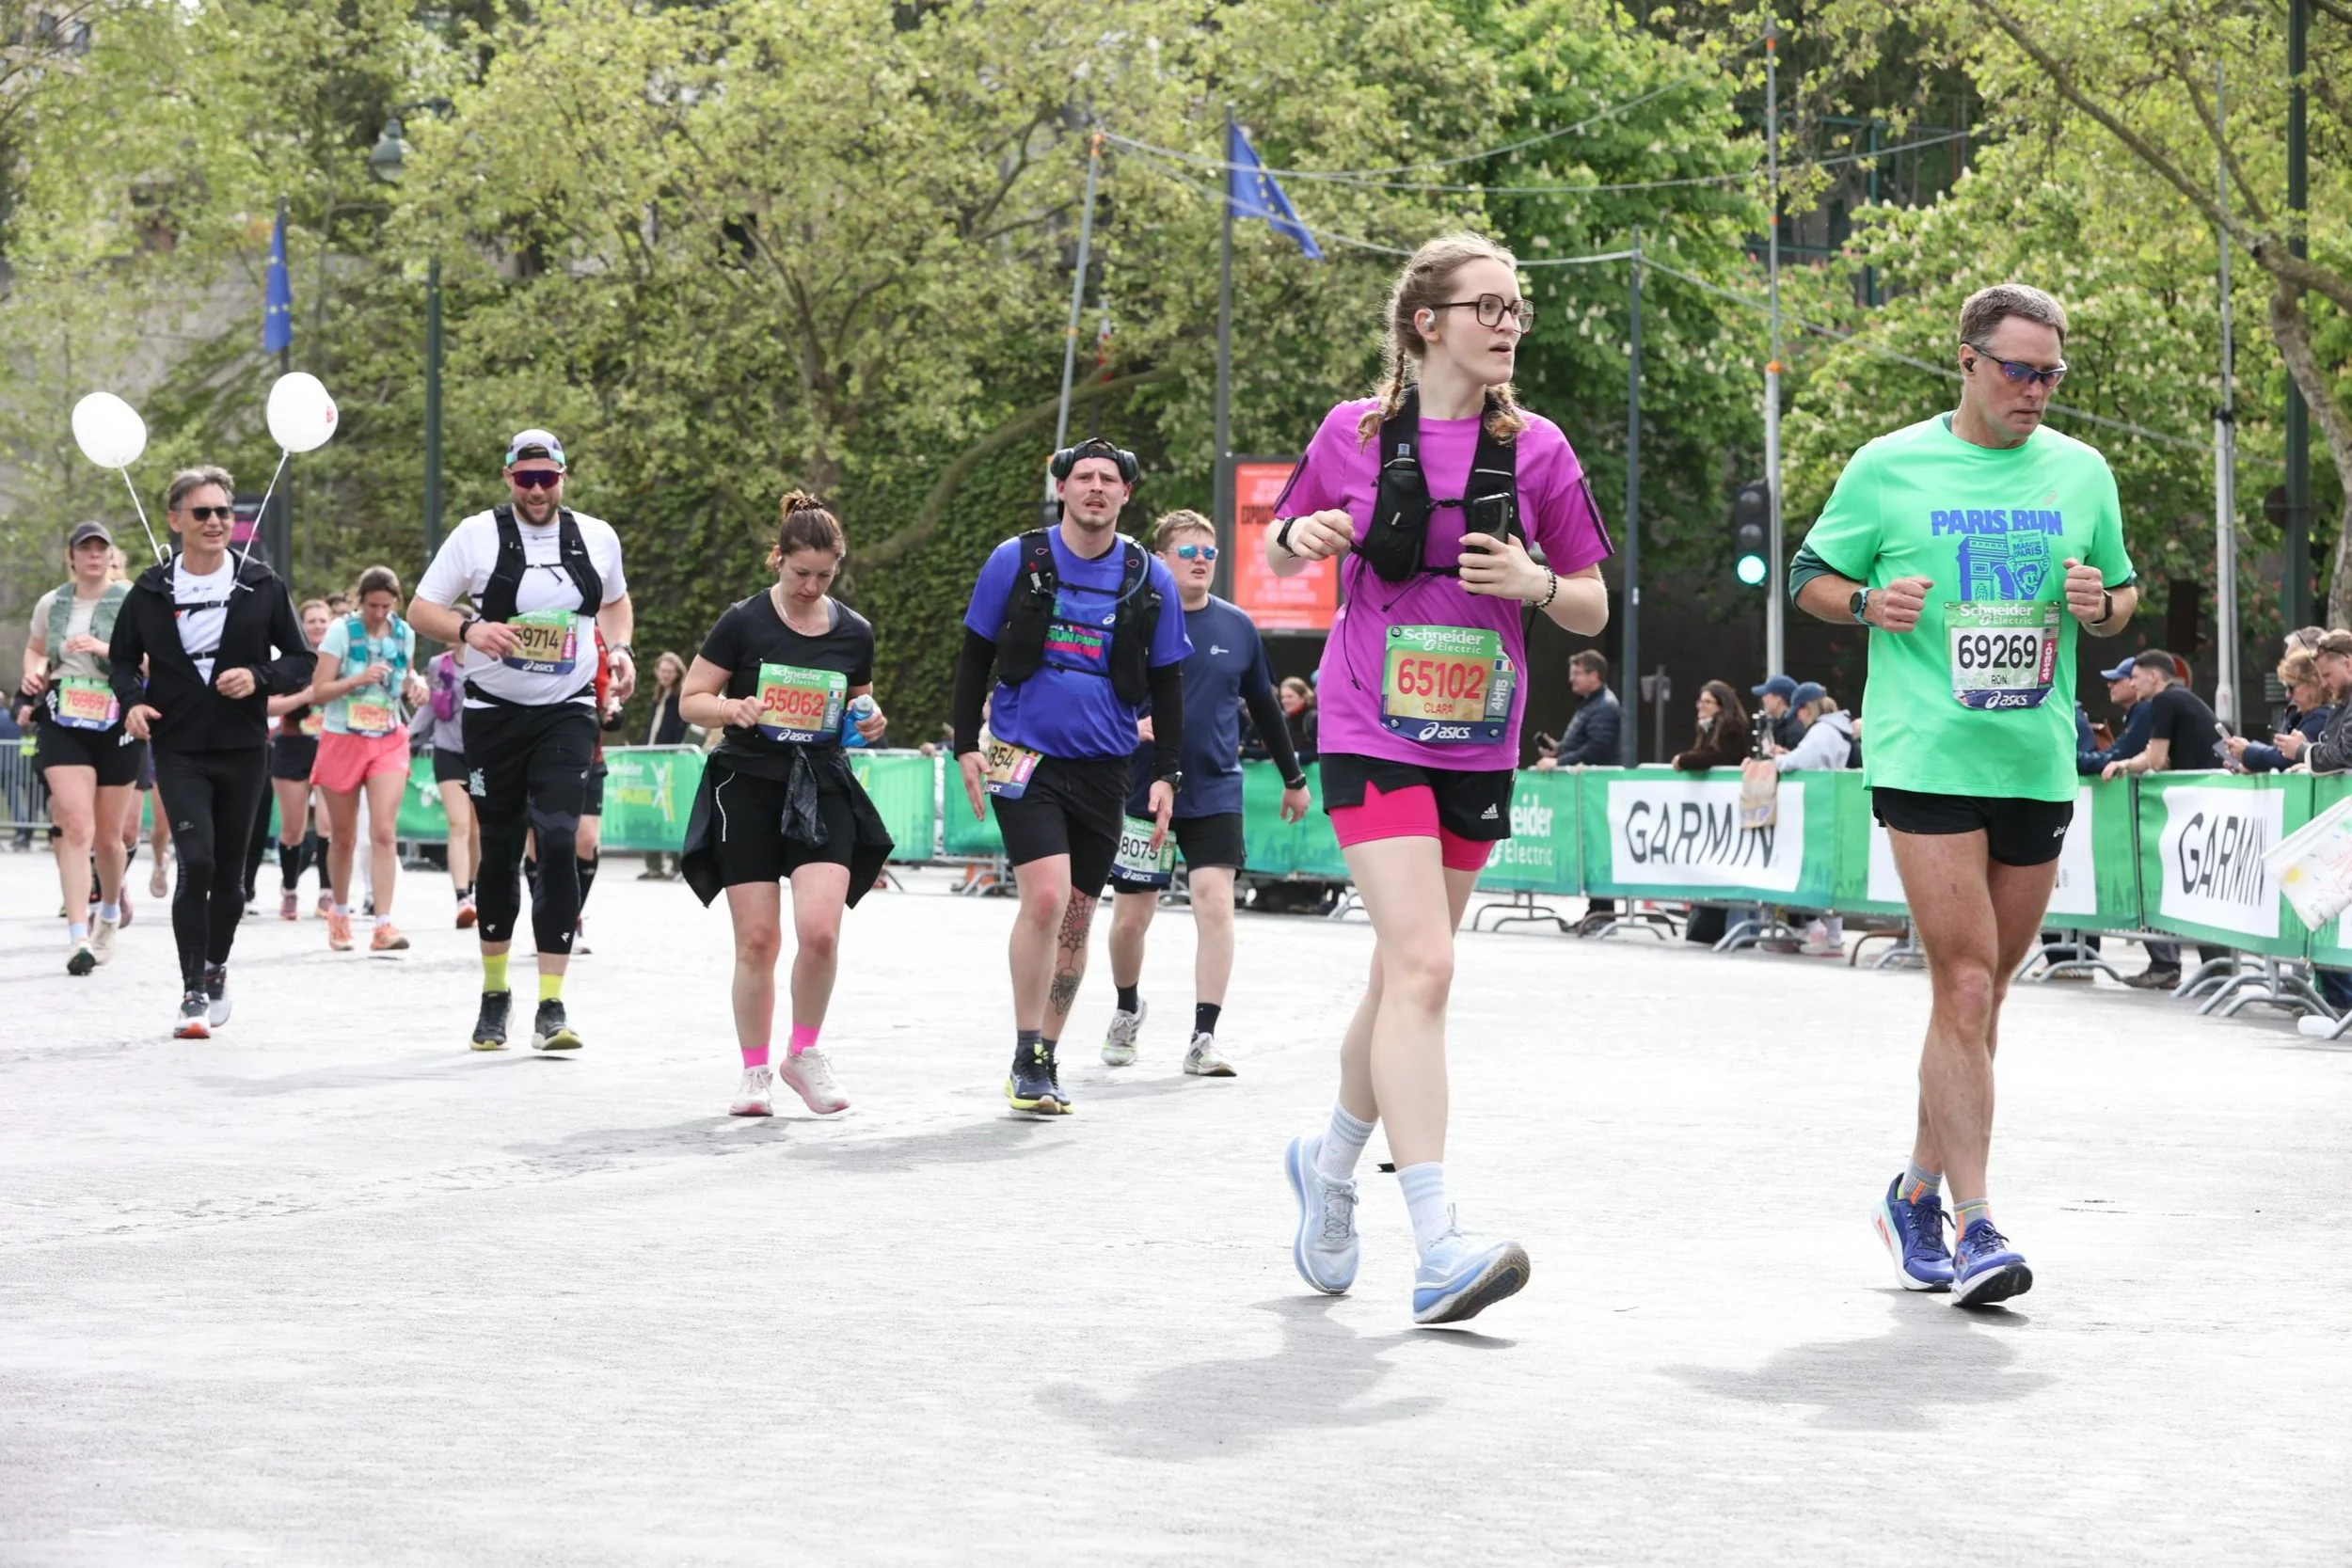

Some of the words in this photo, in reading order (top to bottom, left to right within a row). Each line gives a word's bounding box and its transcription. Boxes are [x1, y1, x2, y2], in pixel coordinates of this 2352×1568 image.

[1931, 510, 2010, 536] PARIS
[2011, 510, 2064, 536] RUN
[1960, 603, 2034, 617] Schneider
[1993, 616, 2033, 625] Electric
[1403, 627, 1485, 645] Schneider
[1438, 641, 1482, 655] Electric
[1958, 634, 2038, 670] 69269
[2041, 641, 2054, 680] 4H30+
[771, 664, 823, 681] Schneider
[1398, 657, 1486, 700] 65102
[1991, 674, 2008, 685] RON
[764, 687, 826, 717] 65062
[1491, 678, 1509, 711] 4H15
[1423, 702, 1454, 715] CLARA
[789, 731, 814, 742] asics
[1438, 725, 1471, 739] asics
[1510, 794, 1554, 837] eider
[1625, 800, 1775, 869] GARMIN
[1505, 839, 1553, 867] Electric
[2178, 811, 2268, 907] GARMIN
